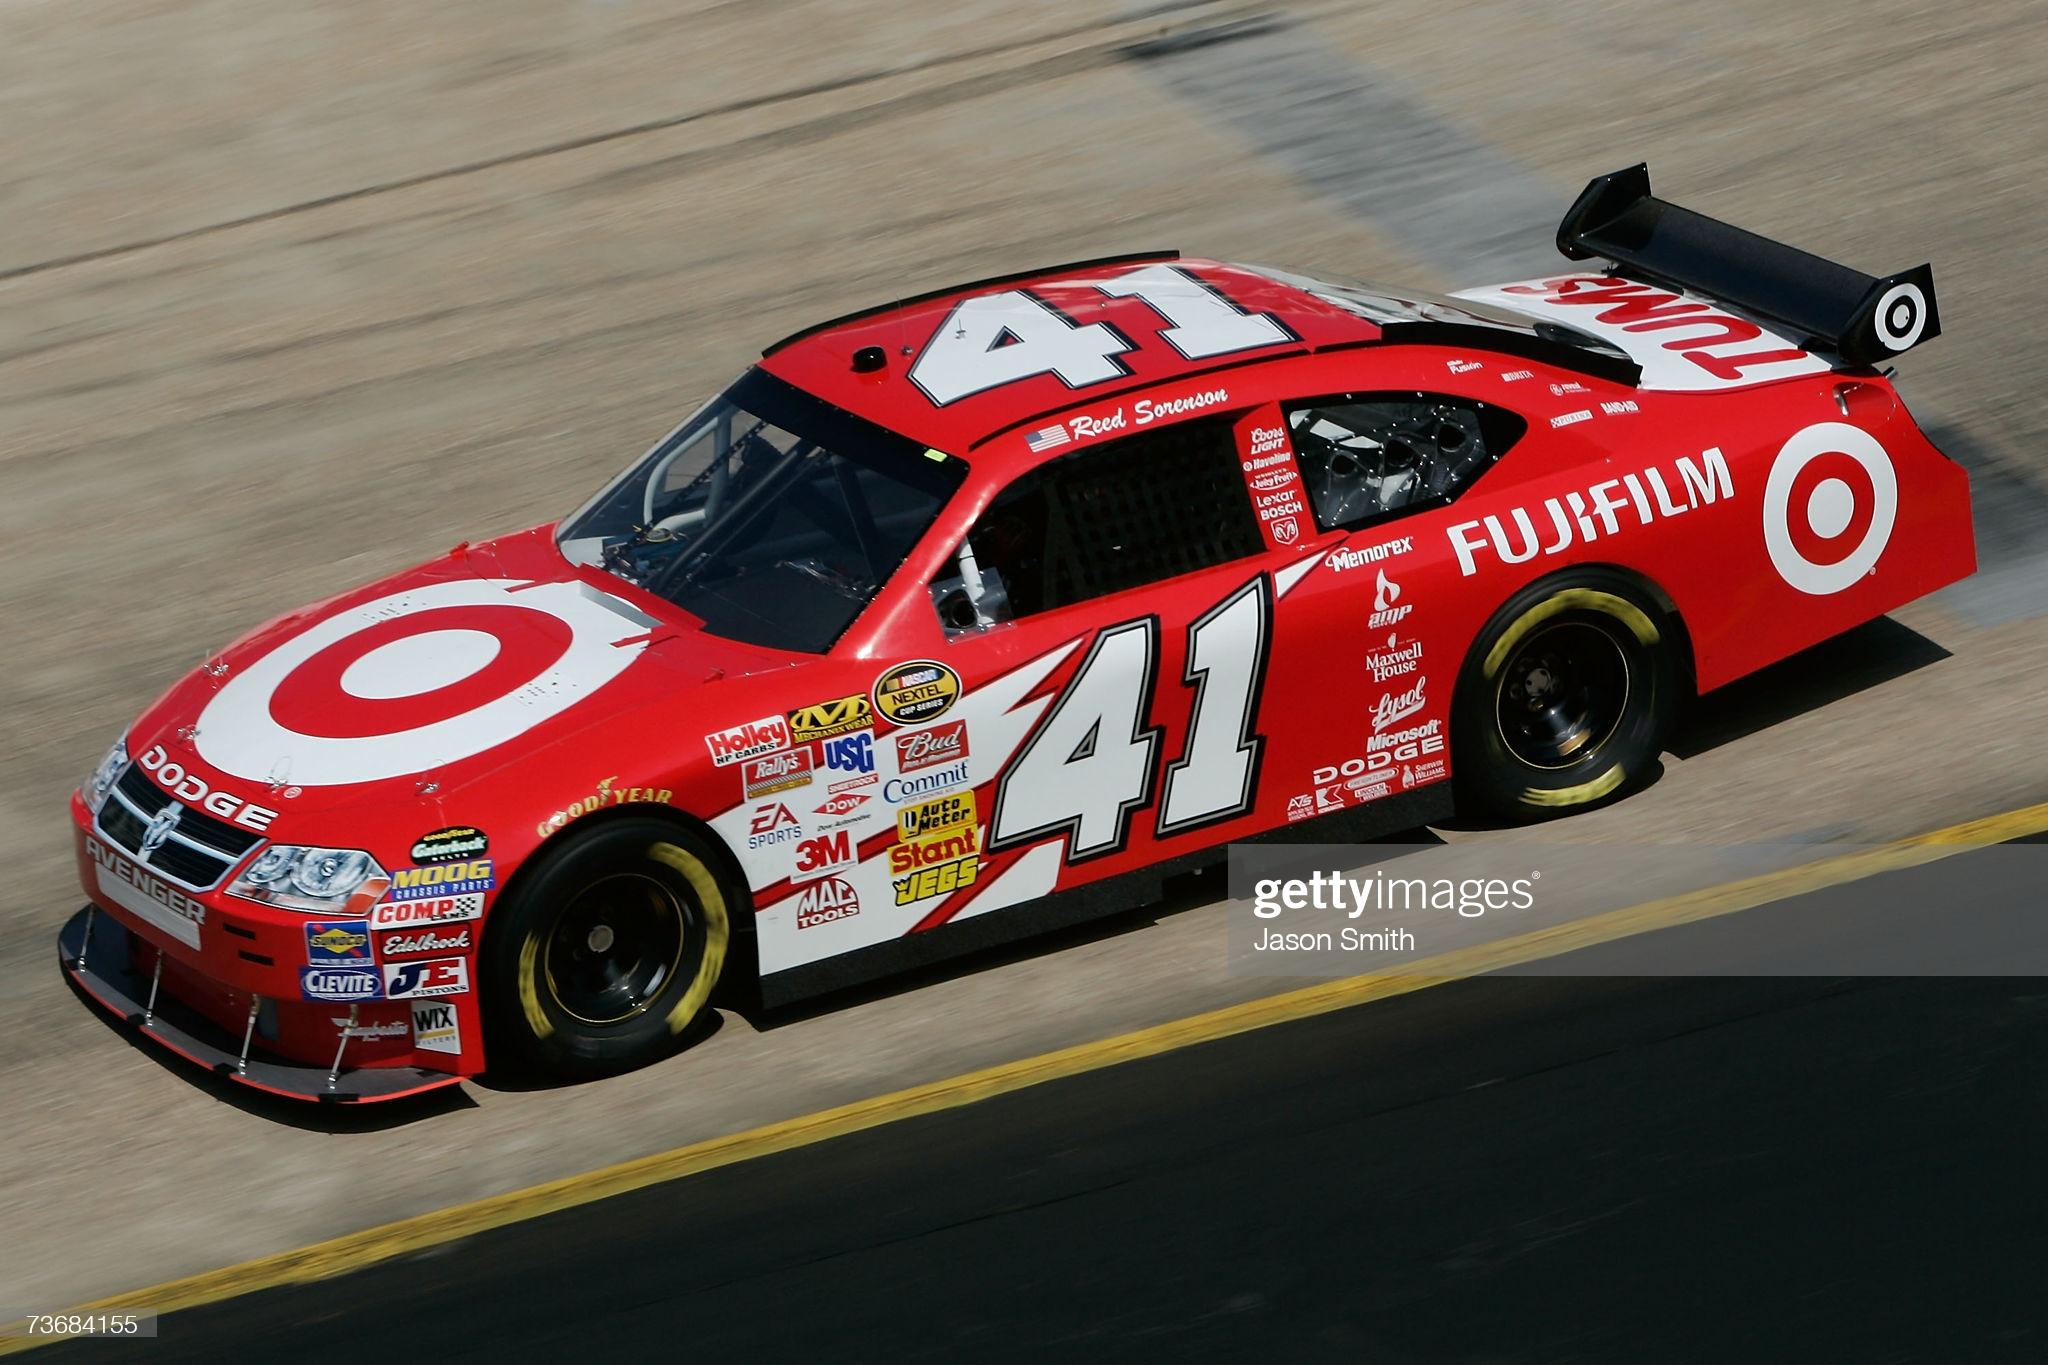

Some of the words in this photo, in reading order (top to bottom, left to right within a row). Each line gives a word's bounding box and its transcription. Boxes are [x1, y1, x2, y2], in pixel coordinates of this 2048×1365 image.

[907, 263, 1303, 408] 41
[1500, 276, 1808, 381] TUMS
[1069, 408, 1126, 441] Reed
[1134, 387, 1229, 424] Sorenson
[1251, 426, 1284, 443] Coors
[1251, 437, 1285, 455] LIGHT
[1274, 472, 1293, 485] Fruit
[1256, 490, 1295, 507] Lexar
[1260, 501, 1303, 521] BOSCH
[1445, 446, 1735, 577] FUJIFILM
[1332, 536, 1413, 573] Memorex
[1365, 642, 1423, 671] Maxwell
[1373, 660, 1417, 683] House
[891, 684, 944, 705] NEXTEL
[1368, 676, 1427, 728] Lysol
[899, 705, 916, 716] CUP
[986, 569, 1274, 868] 41
[709, 721, 787, 756] Holley
[735, 742, 775, 759] CARBS
[897, 725, 964, 761] Bud
[1366, 719, 1439, 753] Microsoft
[755, 752, 799, 779] Rally's
[825, 733, 875, 774] USG
[1312, 735, 1445, 785] DODGE
[139, 744, 280, 832] DODGE
[883, 762, 969, 804] Commit
[749, 802, 800, 836] EA
[826, 796, 861, 813] DOW
[921, 798, 960, 818] Auto
[919, 808, 971, 831] Meter
[749, 826, 802, 849] SPORTS
[796, 830, 851, 872] 3M
[891, 828, 976, 874] Stant
[85, 835, 207, 926] AVENGER
[393, 860, 493, 889] MOOG
[893, 854, 979, 907] JEGS
[396, 885, 446, 900] CHASSIS
[452, 879, 490, 892] PARTS
[377, 899, 455, 924] COMP
[799, 904, 859, 928] TOOLS
[382, 930, 470, 955] Edelbrock
[305, 970, 375, 993] CLEVITE
[389, 958, 461, 997] JE
[412, 984, 468, 998] PISTONS
[414, 1006, 455, 1032] WIX
